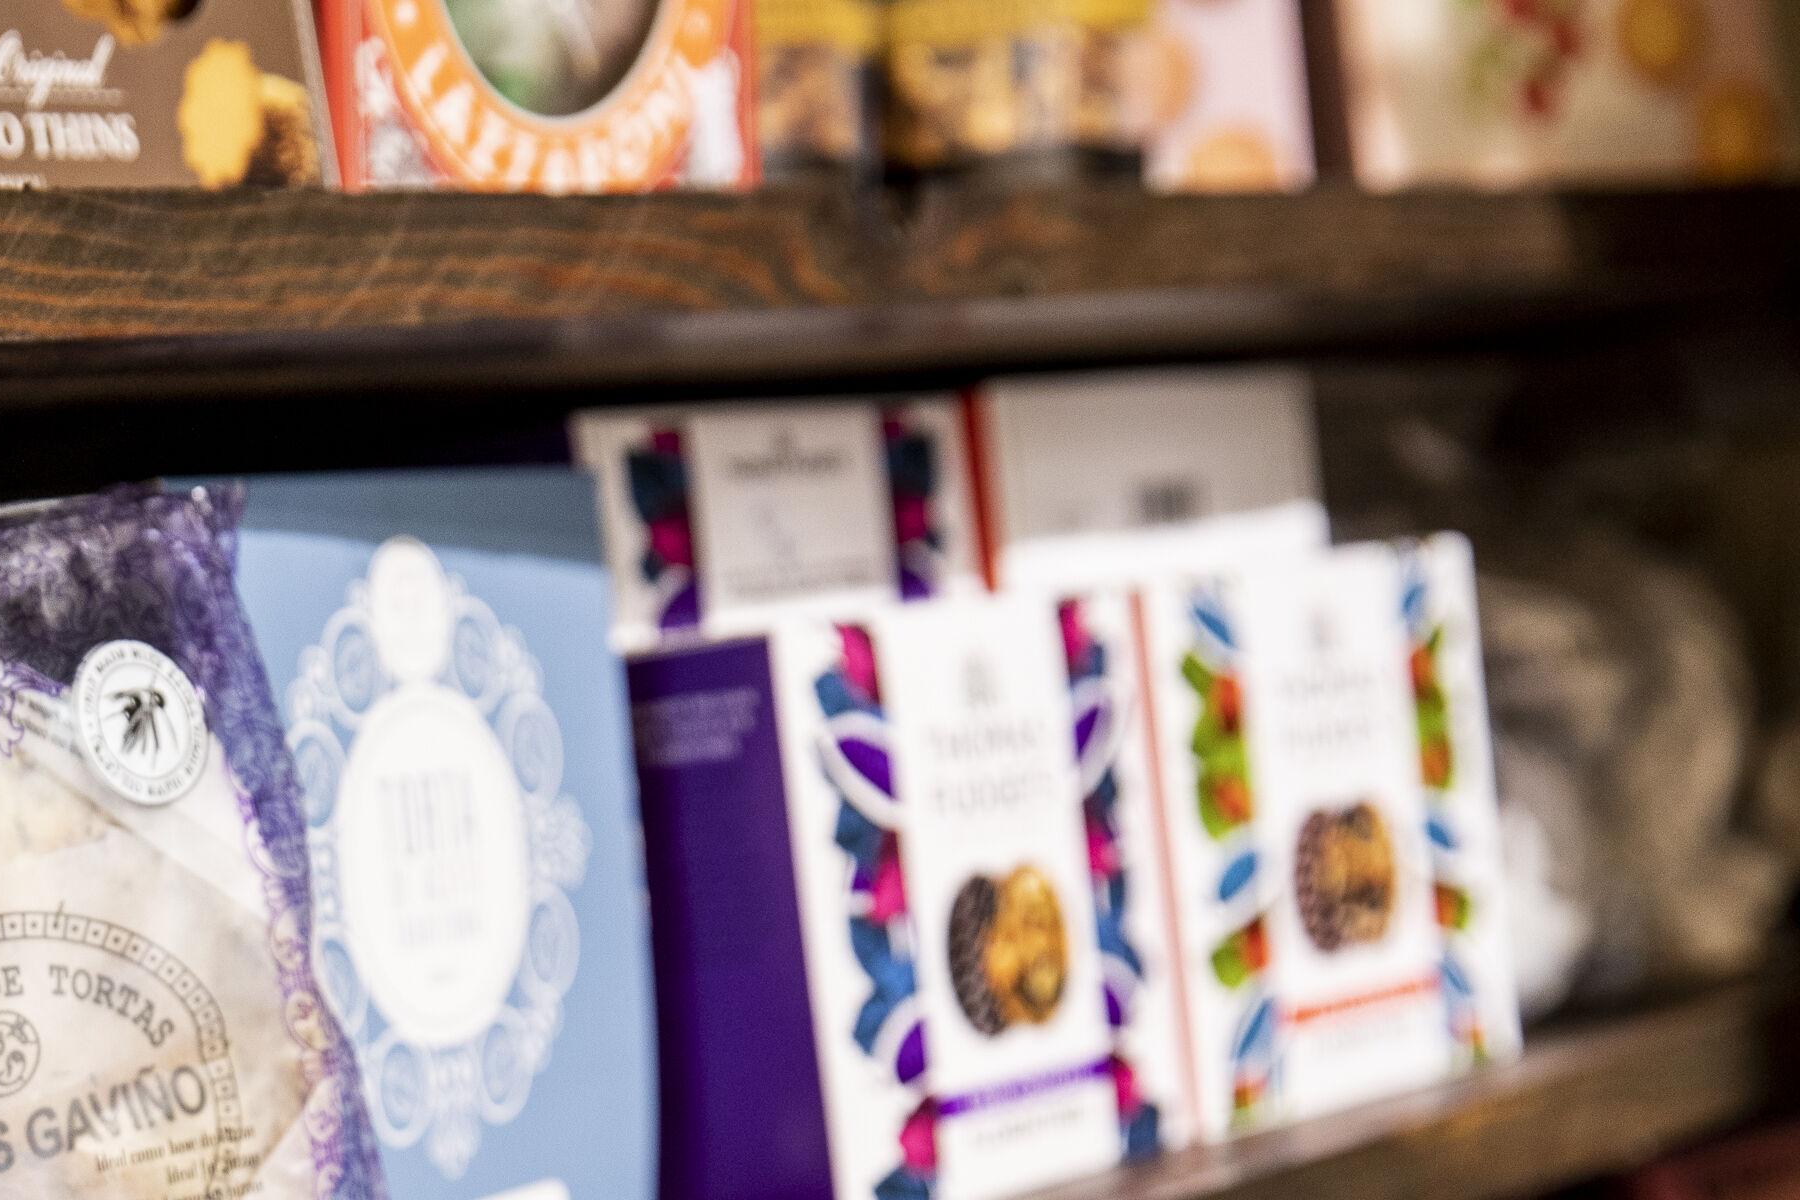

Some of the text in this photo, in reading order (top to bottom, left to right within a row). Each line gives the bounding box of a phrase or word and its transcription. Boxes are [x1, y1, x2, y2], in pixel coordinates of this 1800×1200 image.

[24, 111, 141, 162] THINS
[48, 963, 175, 1048] TORTAS
[26, 1063, 207, 1160] GAVIÑO
